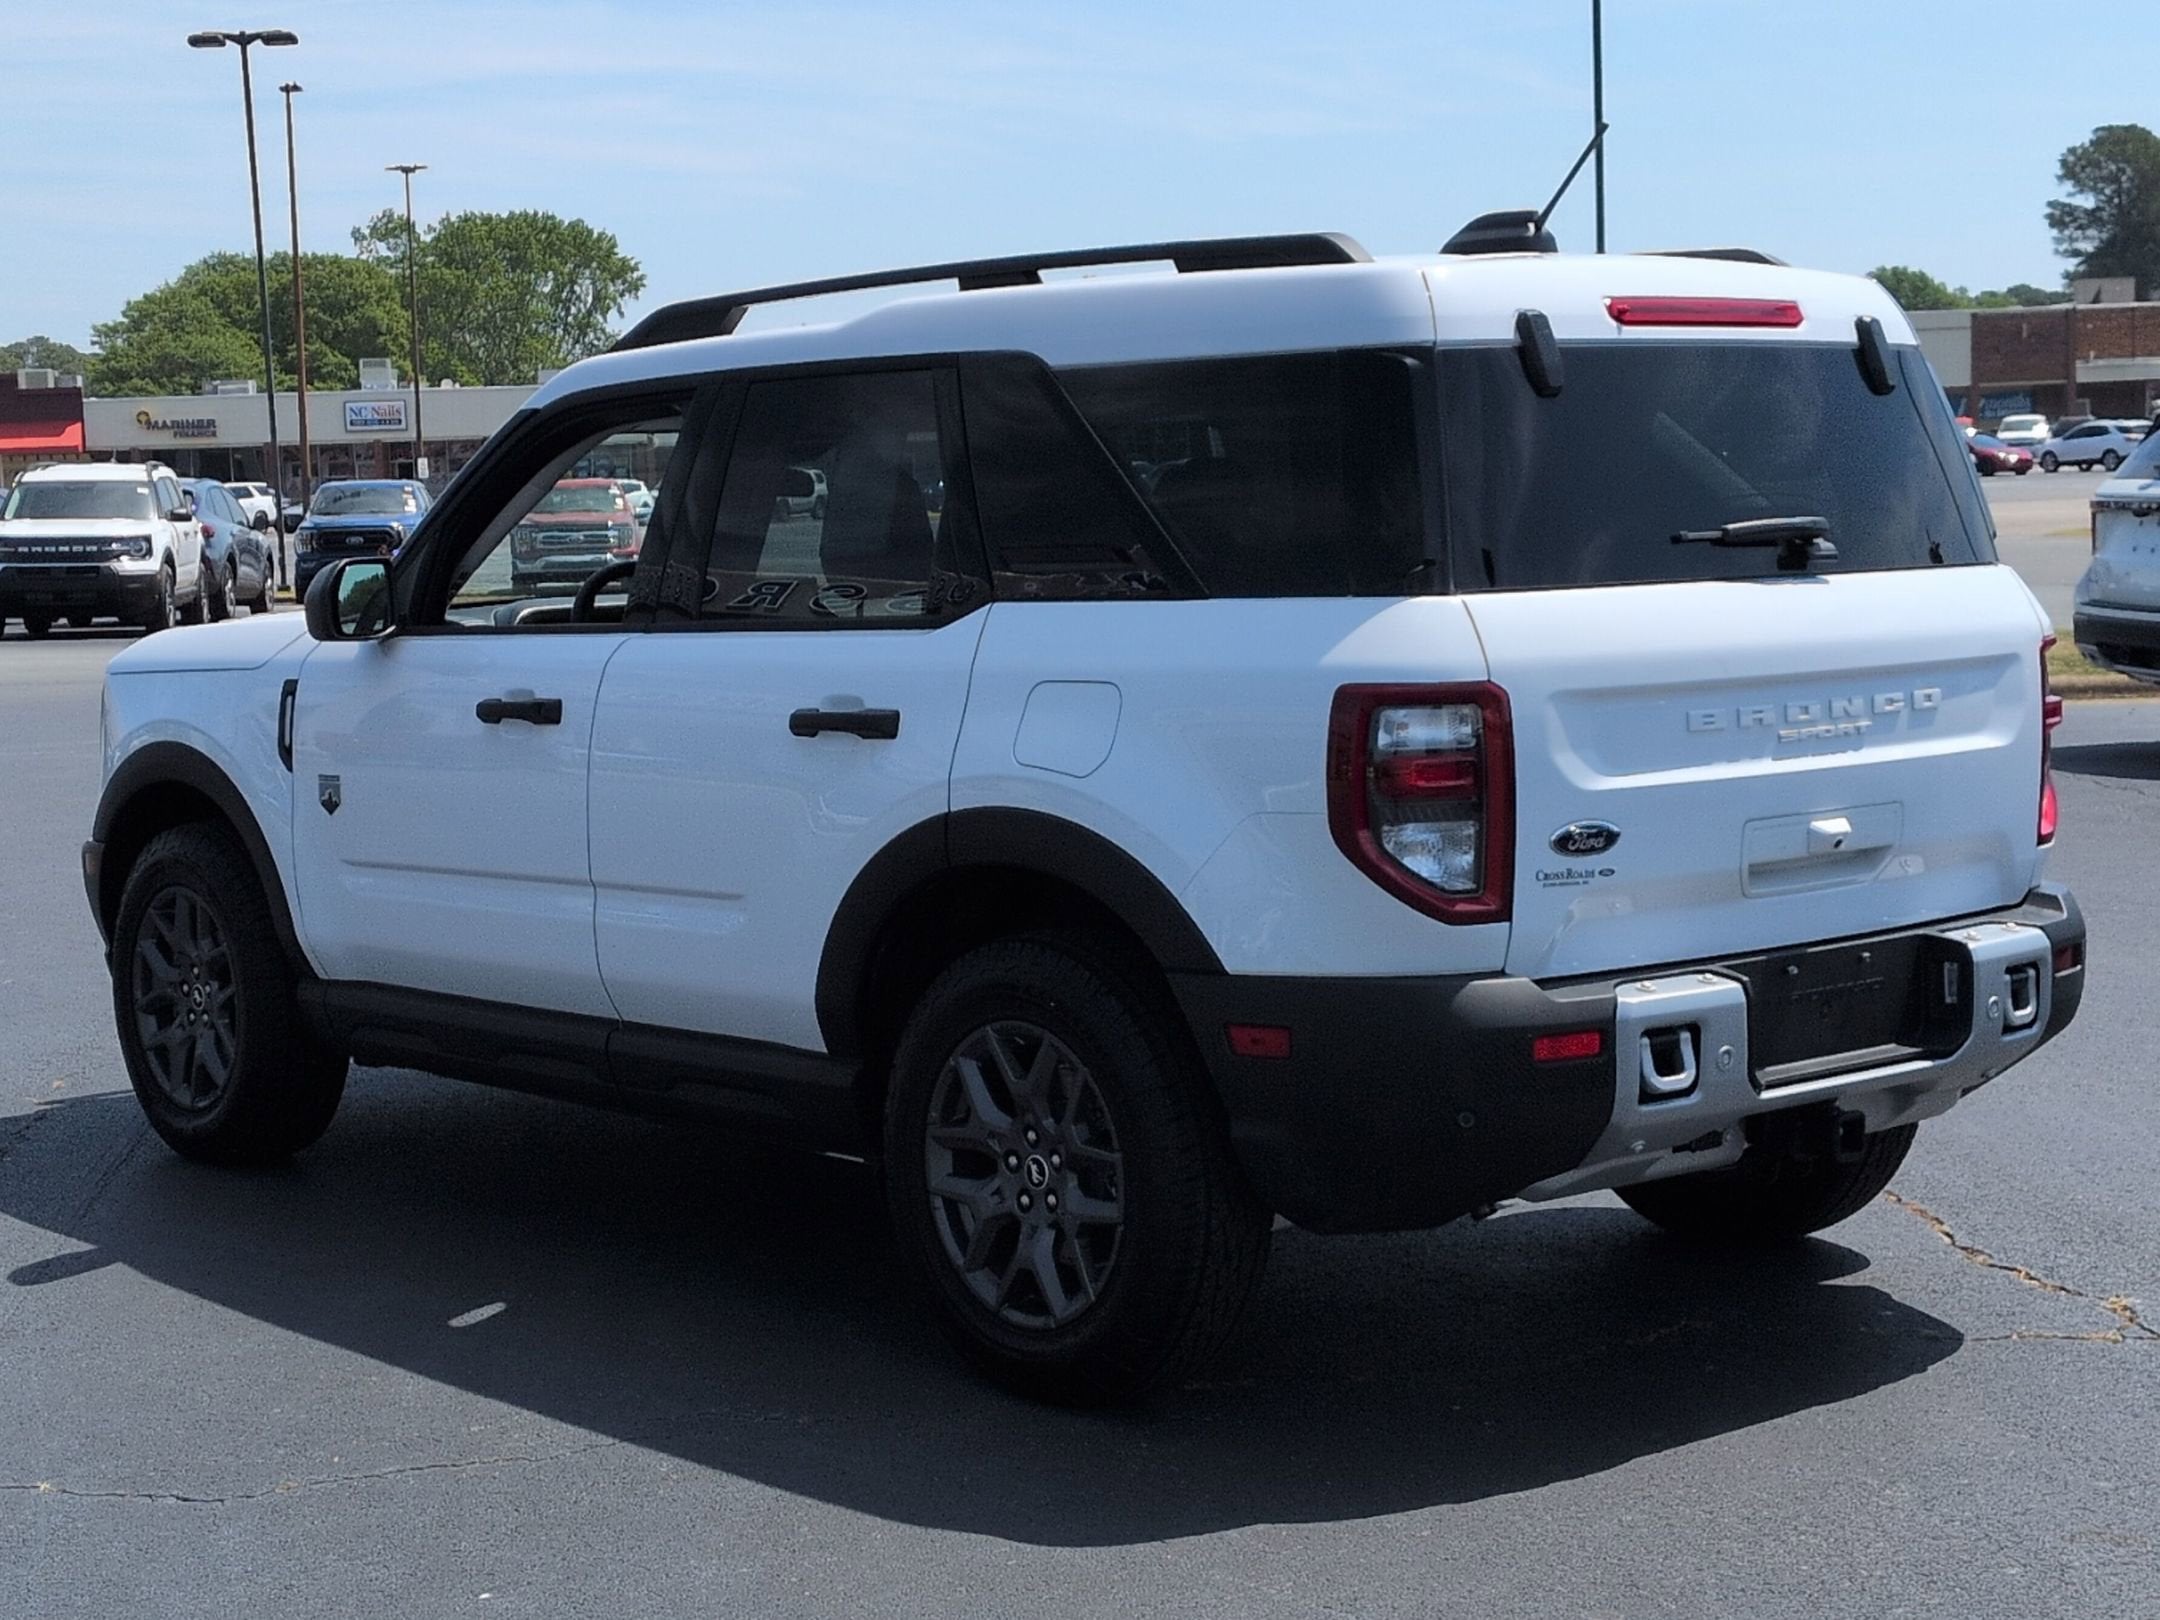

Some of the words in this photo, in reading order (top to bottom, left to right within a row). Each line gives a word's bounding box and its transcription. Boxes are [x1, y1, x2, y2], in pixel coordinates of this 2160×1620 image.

[349, 405, 368, 418] NC
[371, 404, 402, 418] Nails
[145, 418, 216, 430] MARINER
[1687, 688, 1942, 732] BRONCO
[1777, 719, 1873, 744] SPORT
[1566, 827, 1608, 851] Ford
